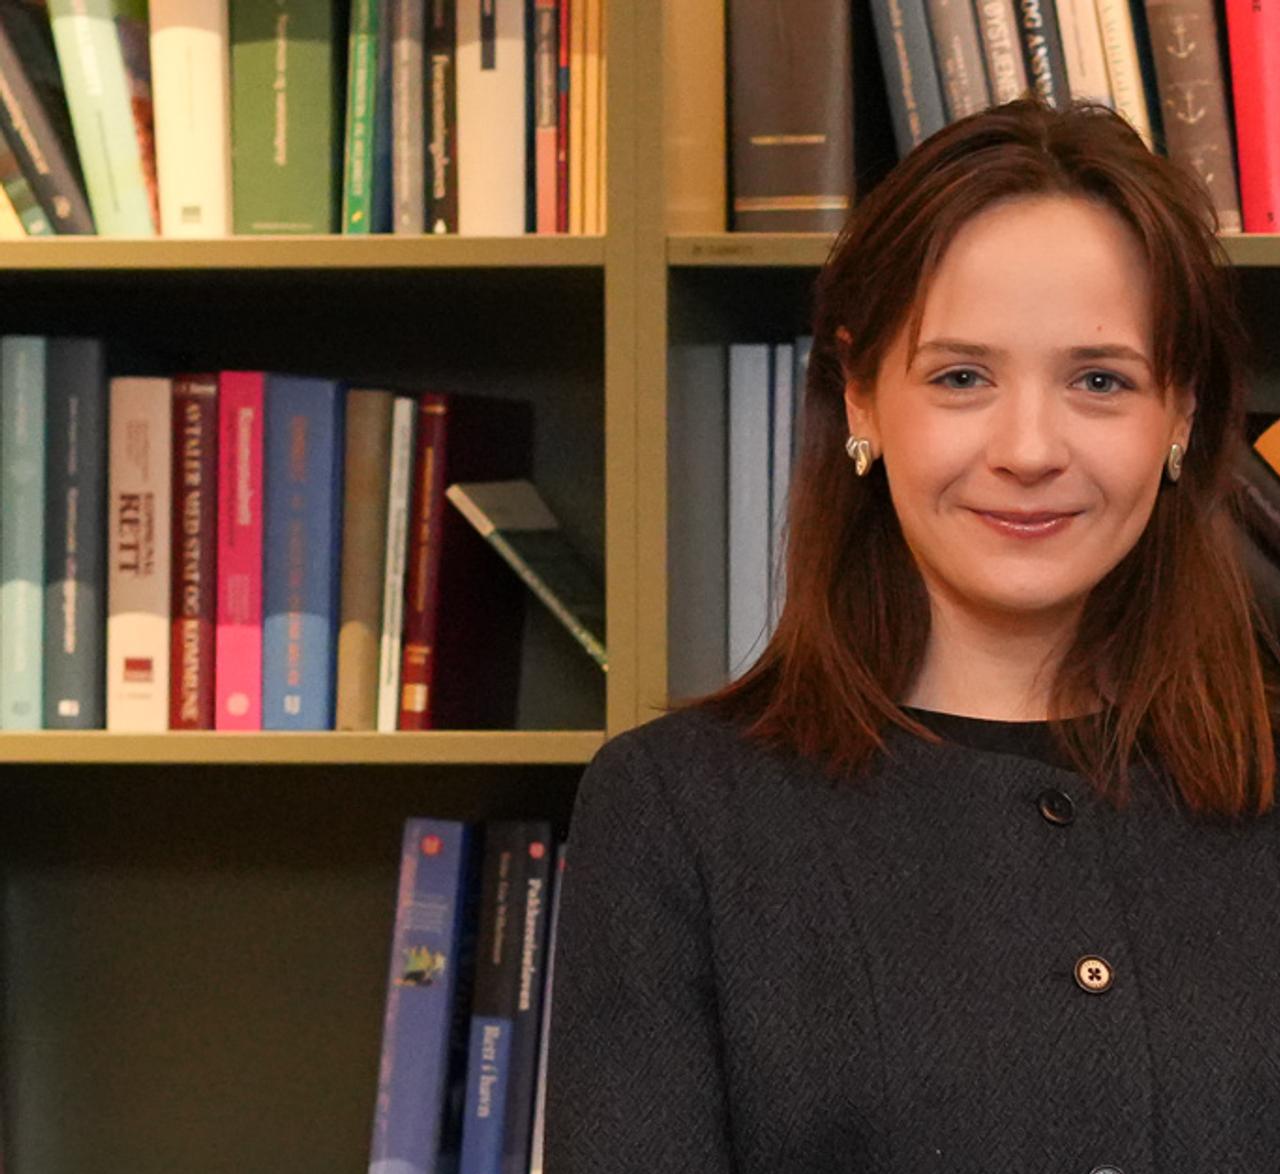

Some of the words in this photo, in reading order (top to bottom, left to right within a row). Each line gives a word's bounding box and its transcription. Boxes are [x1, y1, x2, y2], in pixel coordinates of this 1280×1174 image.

[118, 492, 141, 577] RETT
[482, 1024, 499, 1060] Rett
[477, 1074, 497, 1118] havn
